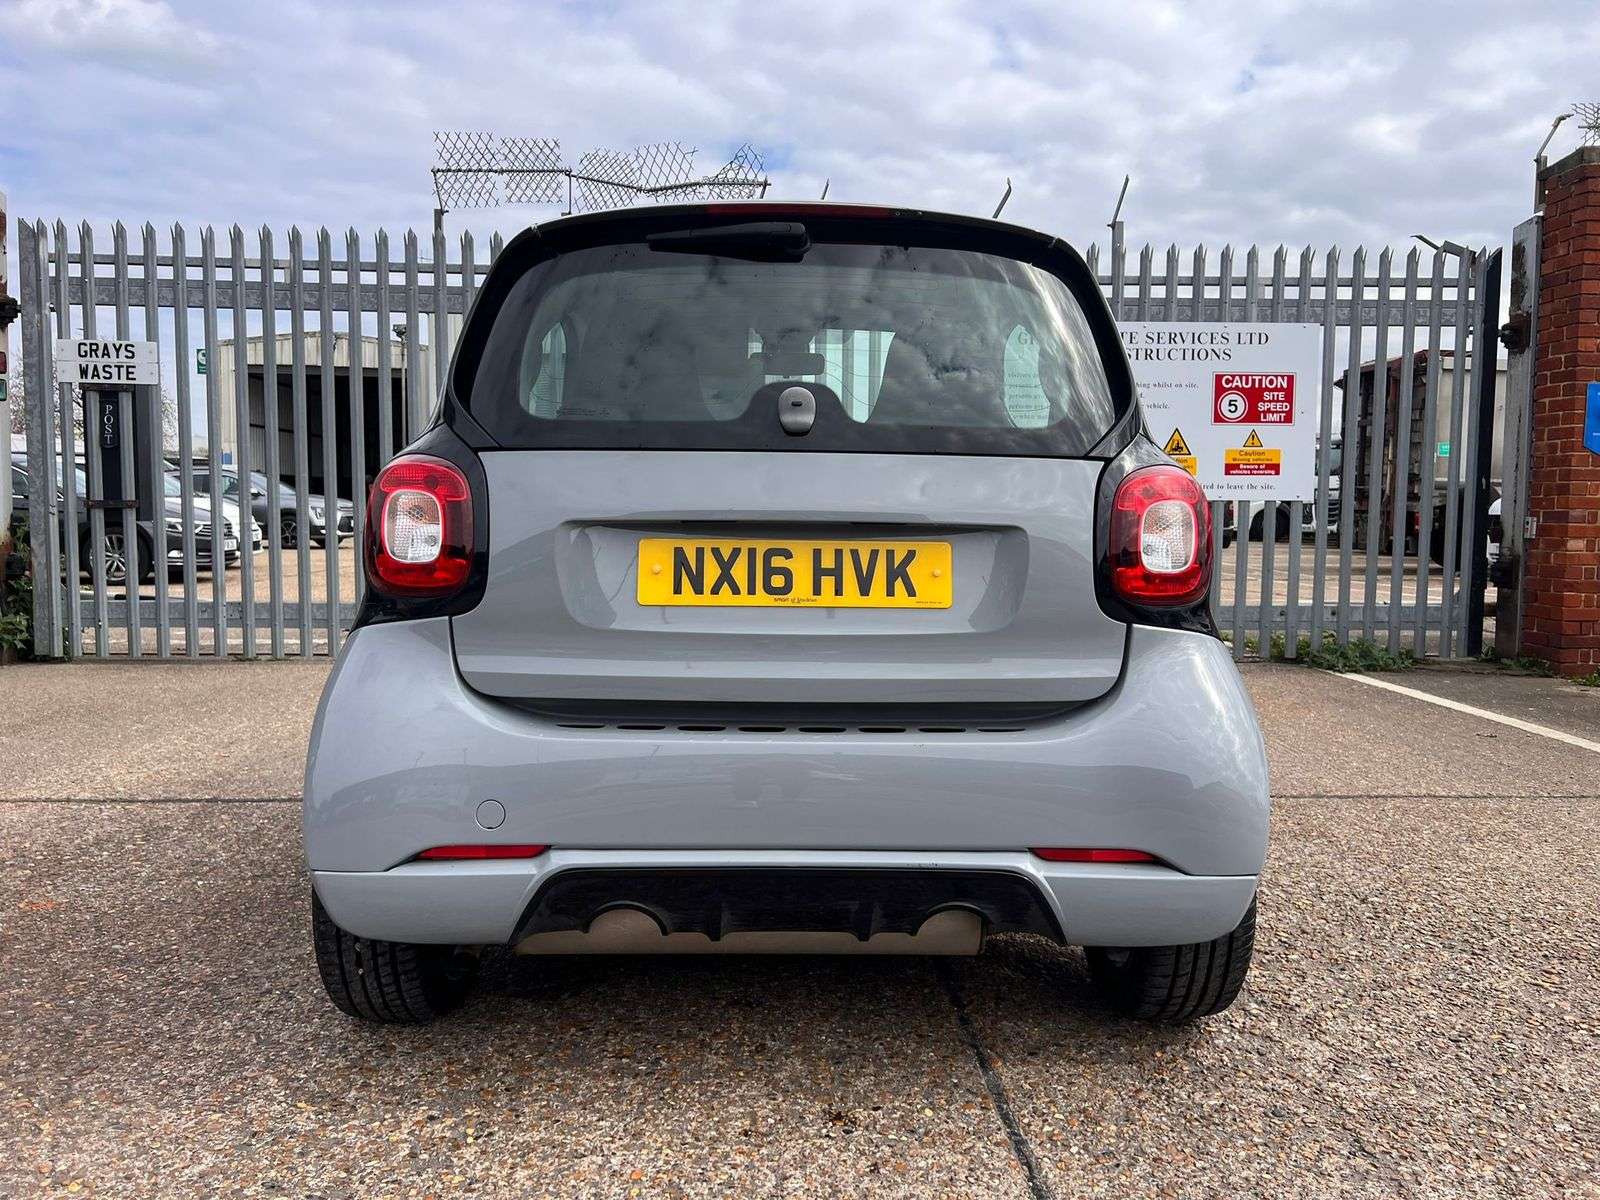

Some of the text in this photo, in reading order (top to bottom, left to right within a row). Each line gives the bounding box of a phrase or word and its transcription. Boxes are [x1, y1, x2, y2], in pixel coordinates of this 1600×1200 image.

[1145, 331, 1230, 346] SERVICES
[1237, 332, 1269, 346] LTD
[77, 342, 135, 359] GRAYS
[79, 363, 137, 381] WASTE
[1221, 375, 1288, 389] CAUTION
[1263, 391, 1285, 401] SITE
[1228, 399, 1238, 414] 5
[1257, 402, 1290, 411] SPEED
[104, 404, 114, 445] POST
[1260, 413, 1286, 422] LIMIT
[673, 546, 917, 598] NX16 HVK
